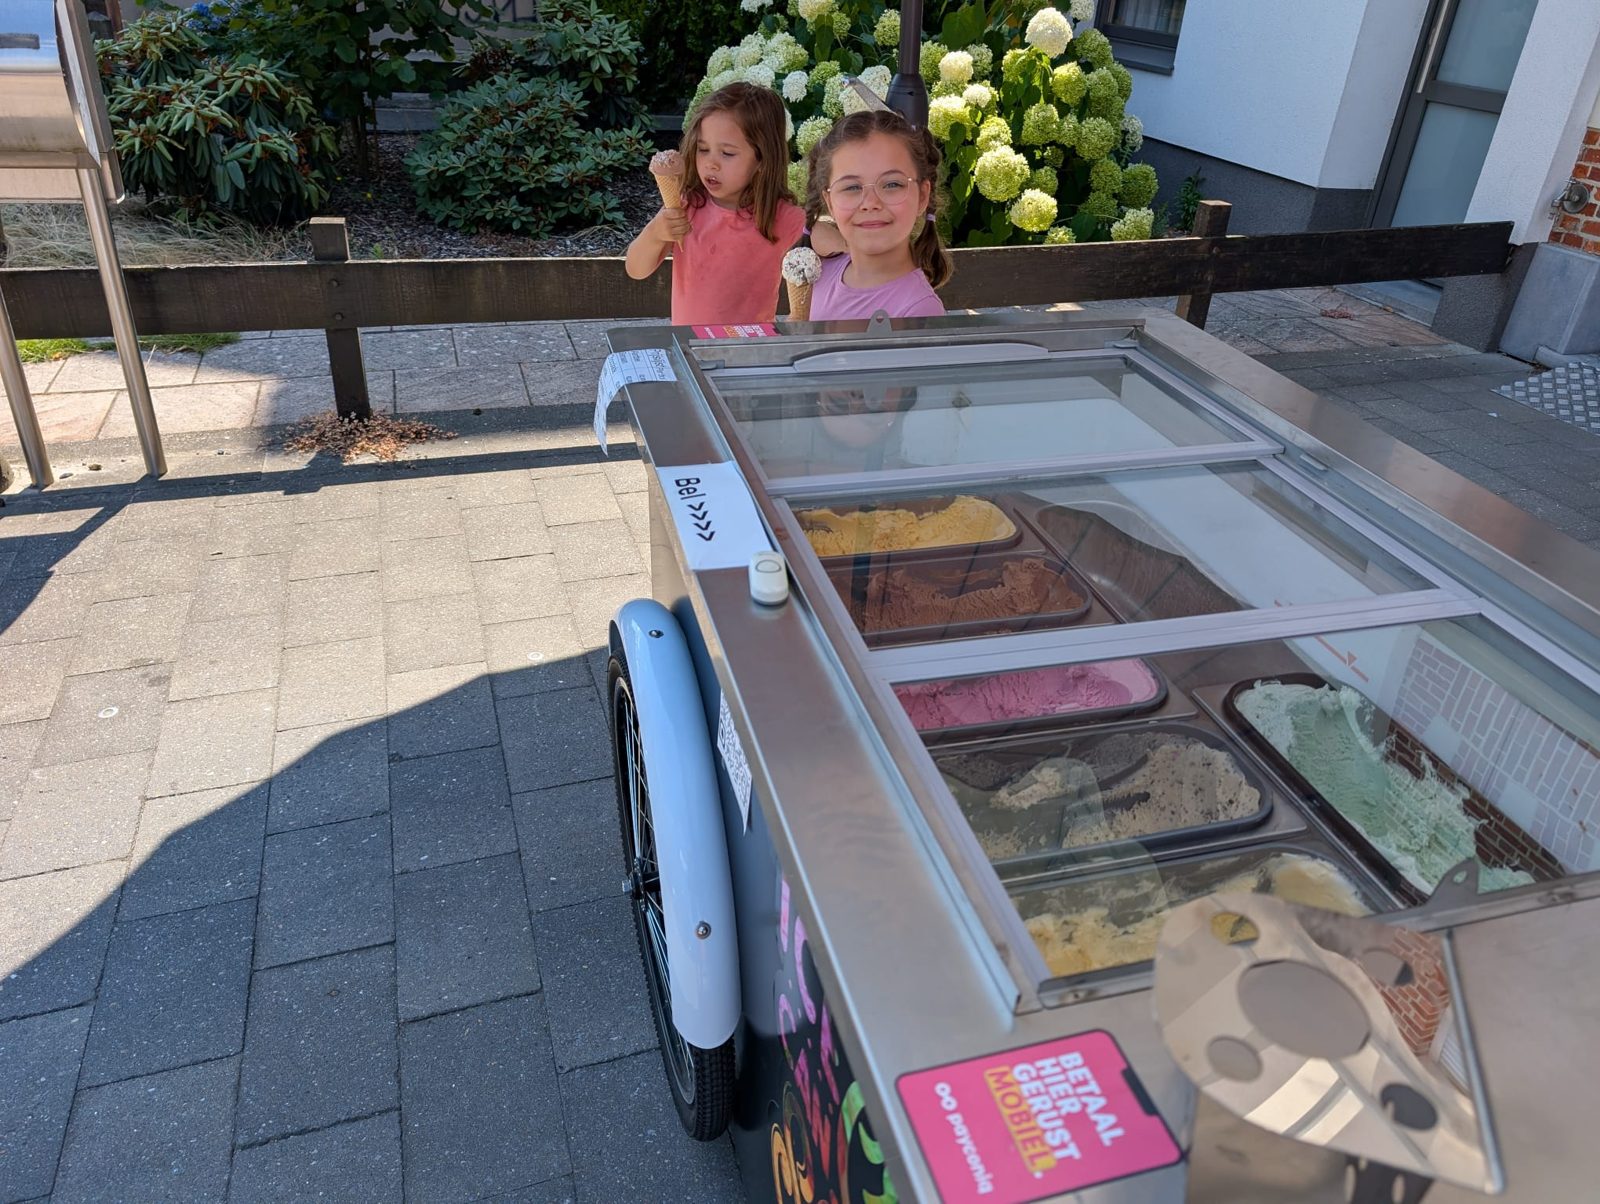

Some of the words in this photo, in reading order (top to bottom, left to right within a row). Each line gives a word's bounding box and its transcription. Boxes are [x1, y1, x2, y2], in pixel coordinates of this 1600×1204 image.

[674, 477, 706, 500] Bel
[988, 1069, 1050, 1179] MOBIEL.
[1012, 1063, 1081, 1160] GERUST
[1035, 1057, 1081, 1115] HIER
[1058, 1052, 1125, 1146] BETAAL
[946, 1112, 994, 1195] payconiq
